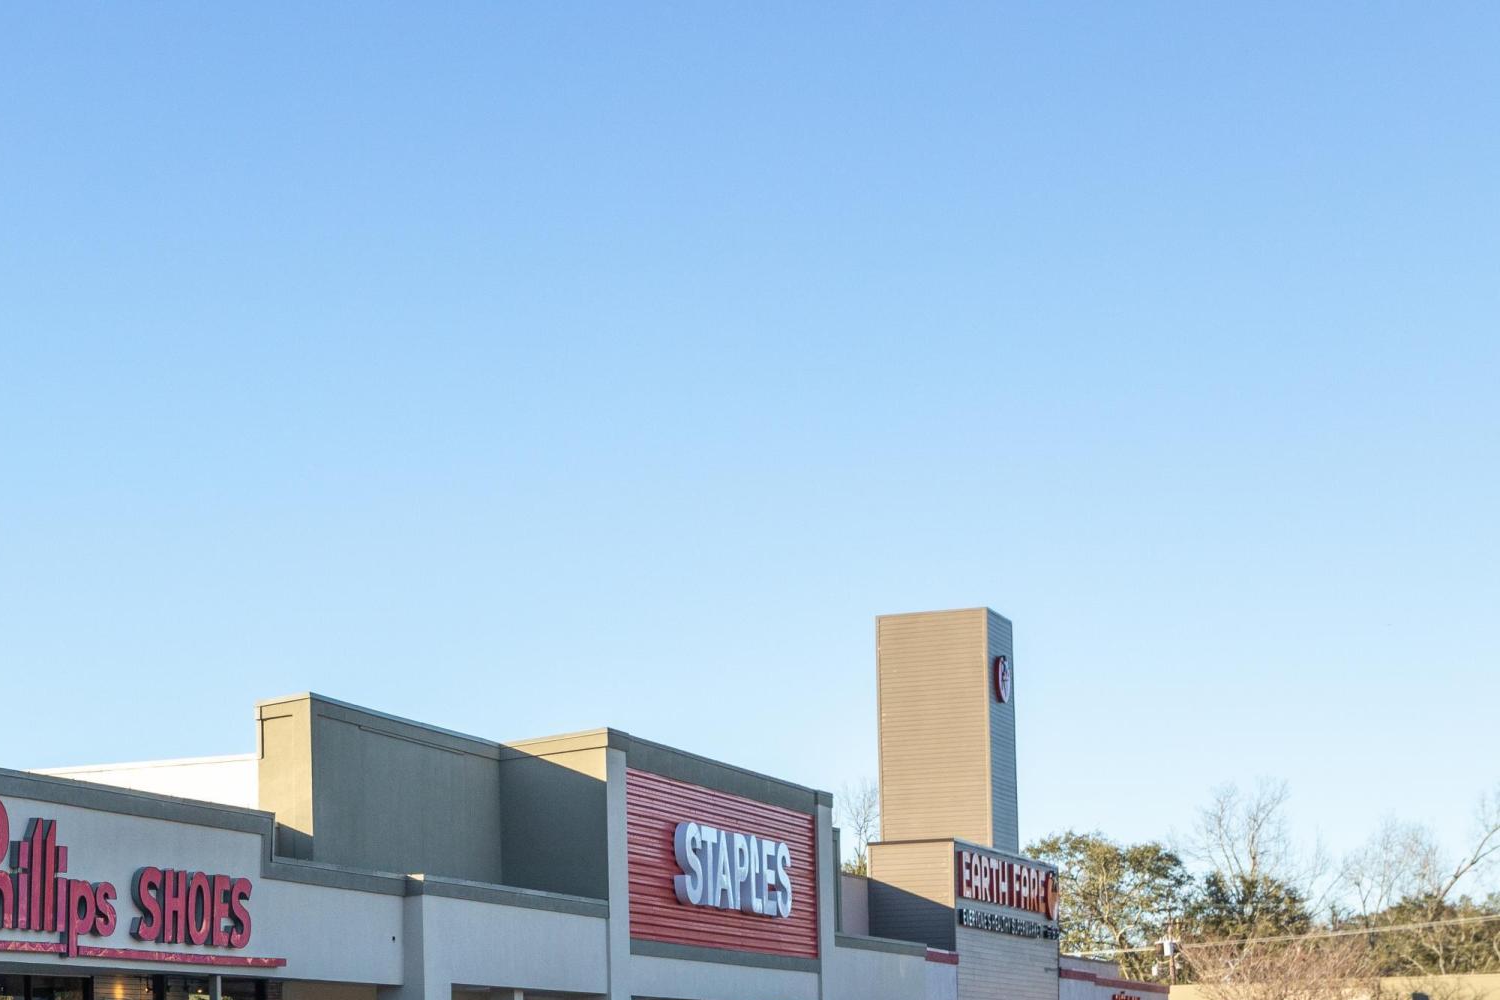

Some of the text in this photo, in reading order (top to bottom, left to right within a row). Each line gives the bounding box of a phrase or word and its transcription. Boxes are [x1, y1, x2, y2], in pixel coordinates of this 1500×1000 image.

[130, 866, 252, 949] SHOES
[674, 822, 792, 918] STAPLES
[959, 851, 1046, 913] EARTH FARE
